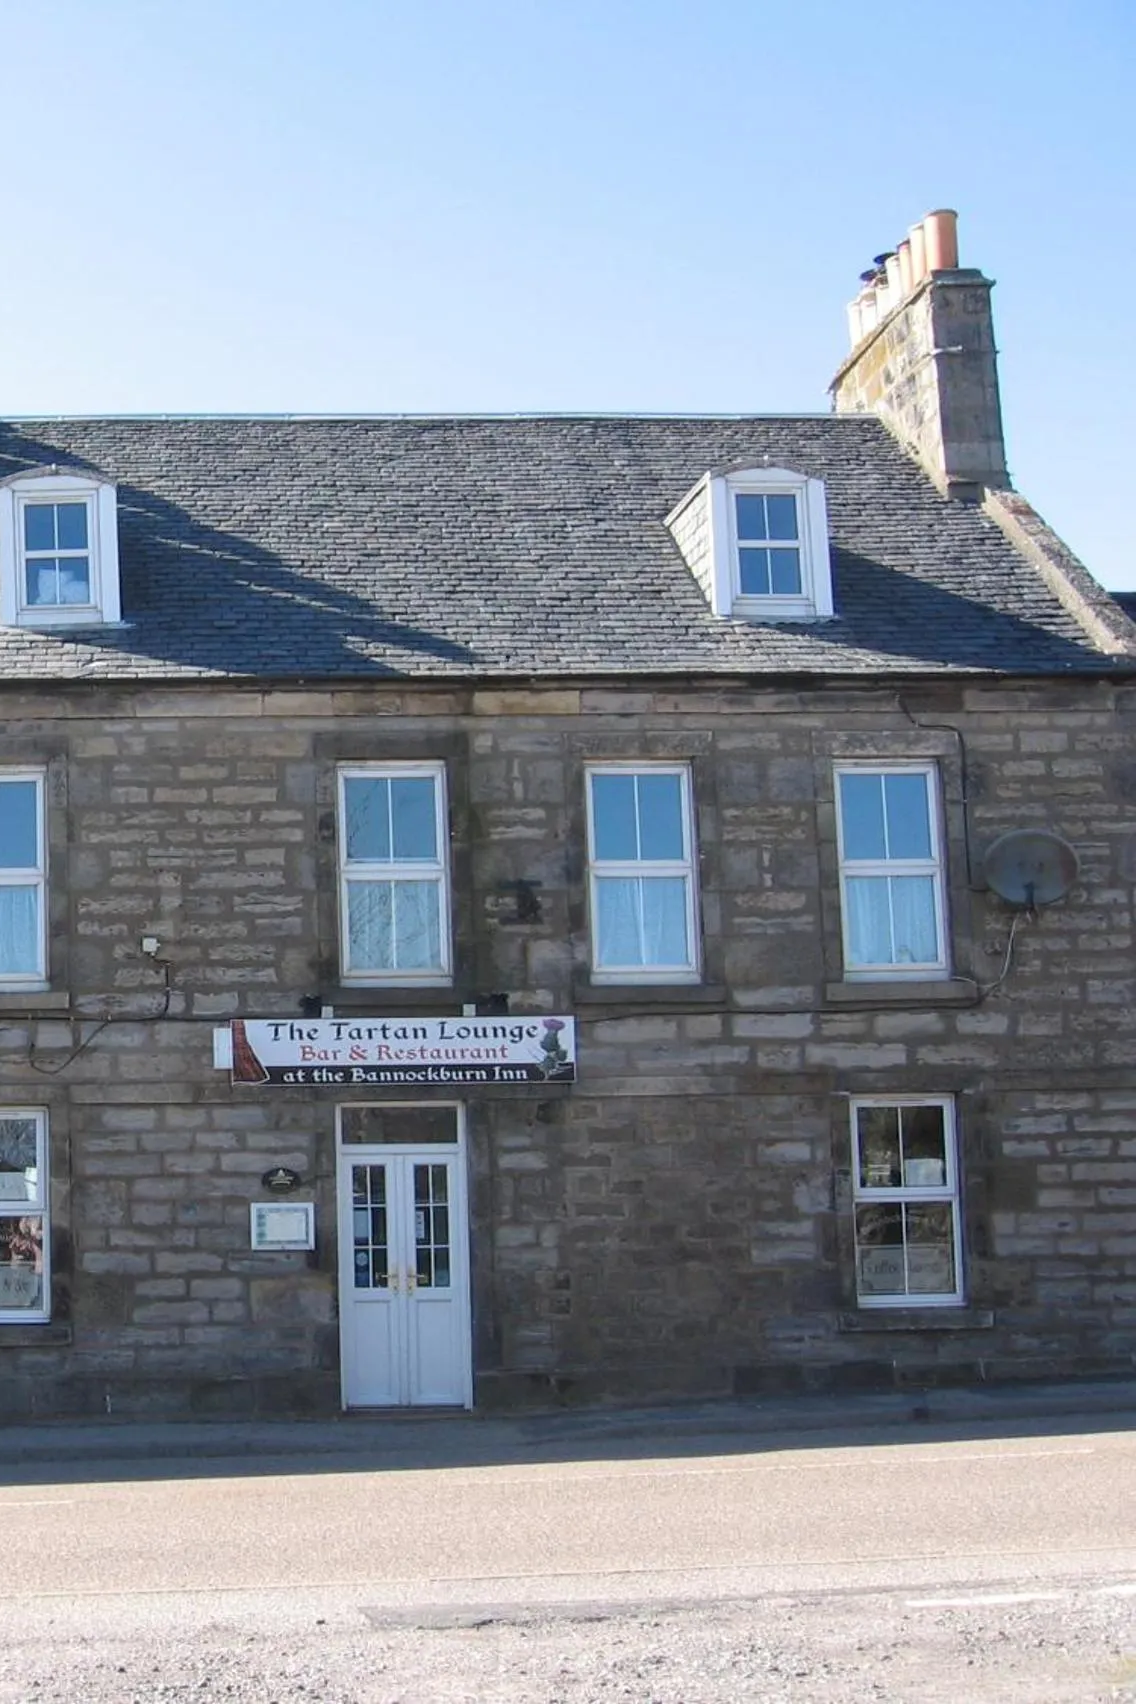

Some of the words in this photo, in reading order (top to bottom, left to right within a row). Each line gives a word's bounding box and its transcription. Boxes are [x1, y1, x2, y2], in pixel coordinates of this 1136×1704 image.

[266, 1021, 319, 1041] The
[329, 1021, 427, 1041] Tartan
[438, 1020, 538, 1043] Lounge
[300, 1044, 341, 1061] Bar
[349, 1044, 367, 1061] &
[376, 1043, 509, 1061] Restaurant
[283, 1068, 306, 1082] at
[313, 1067, 345, 1082] the
[351, 1066, 487, 1082] Bannockburn
[492, 1065, 528, 1081] Inn
